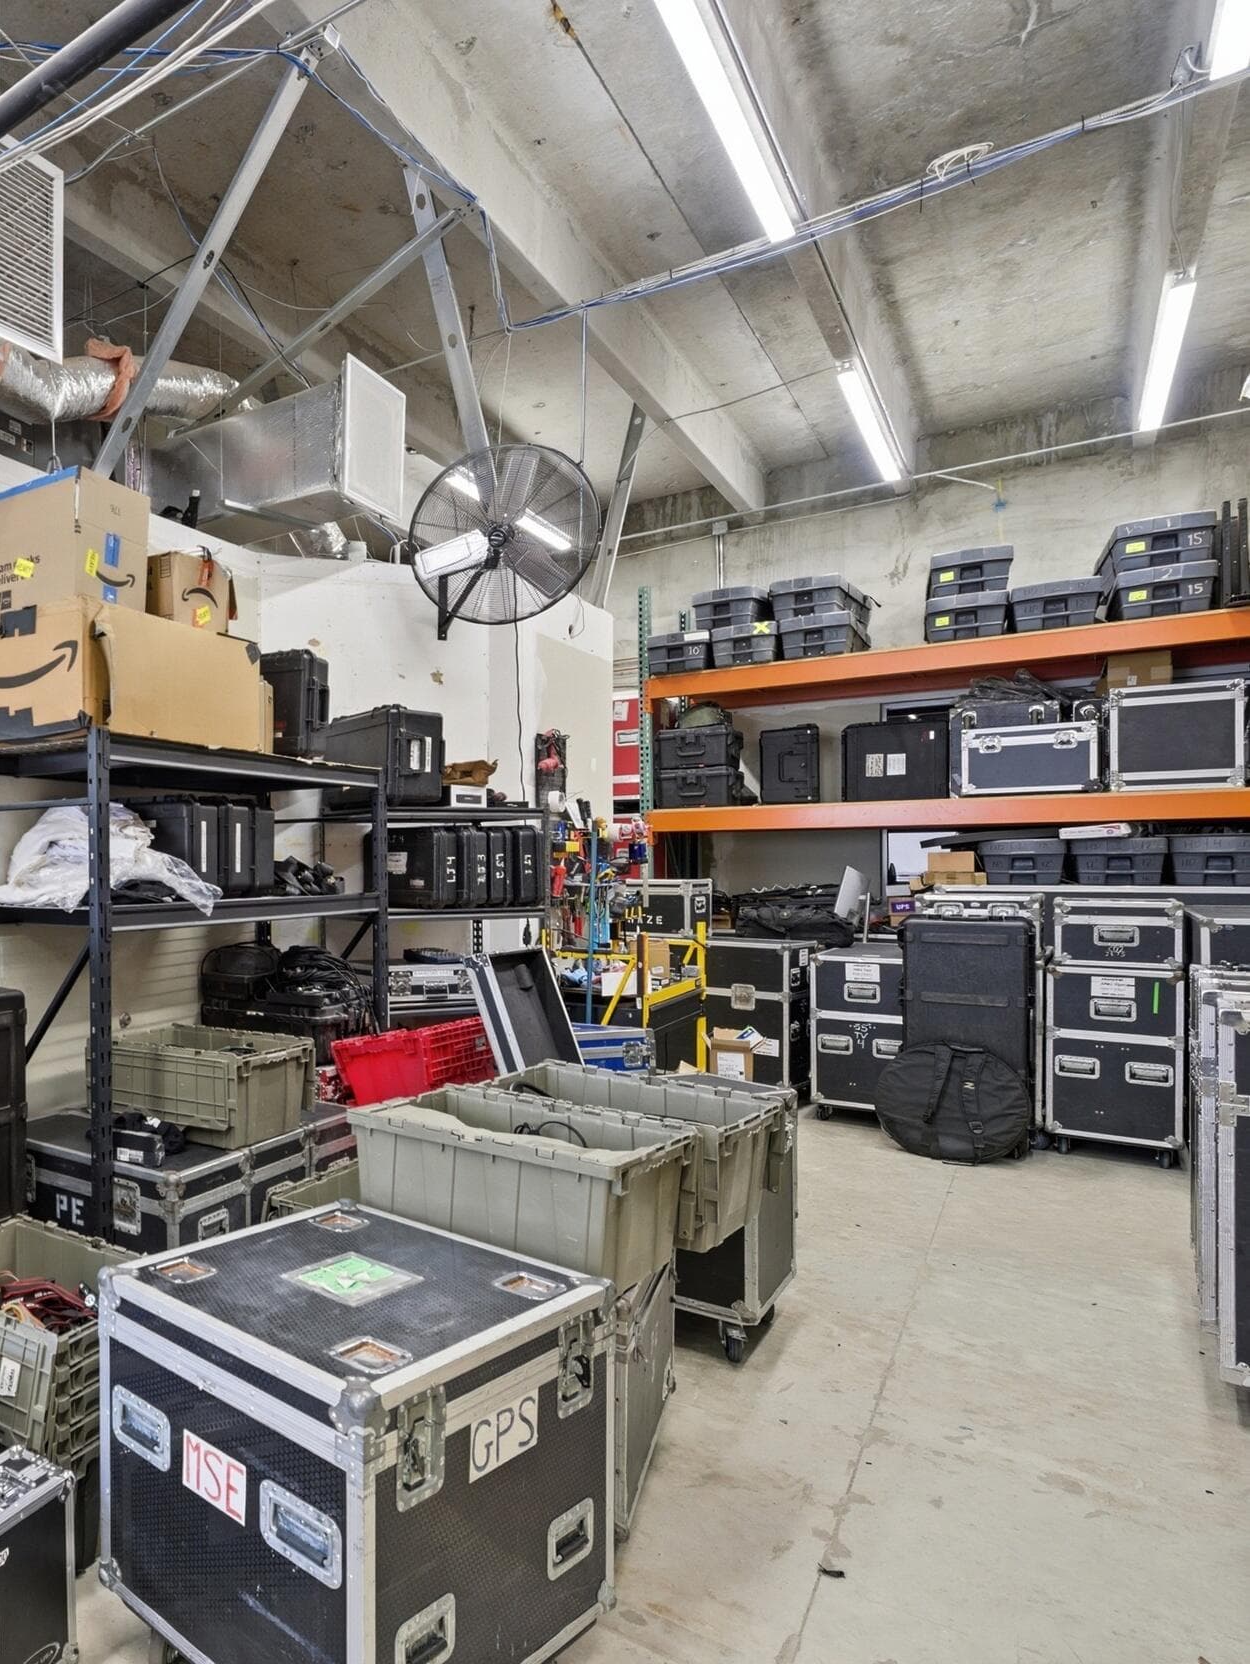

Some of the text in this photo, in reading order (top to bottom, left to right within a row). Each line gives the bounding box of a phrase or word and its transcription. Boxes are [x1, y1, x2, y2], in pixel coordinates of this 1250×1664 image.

[55, 1193, 85, 1226] PE
[472, 1396, 536, 1473] GPS
[184, 1433, 245, 1519] MSE
